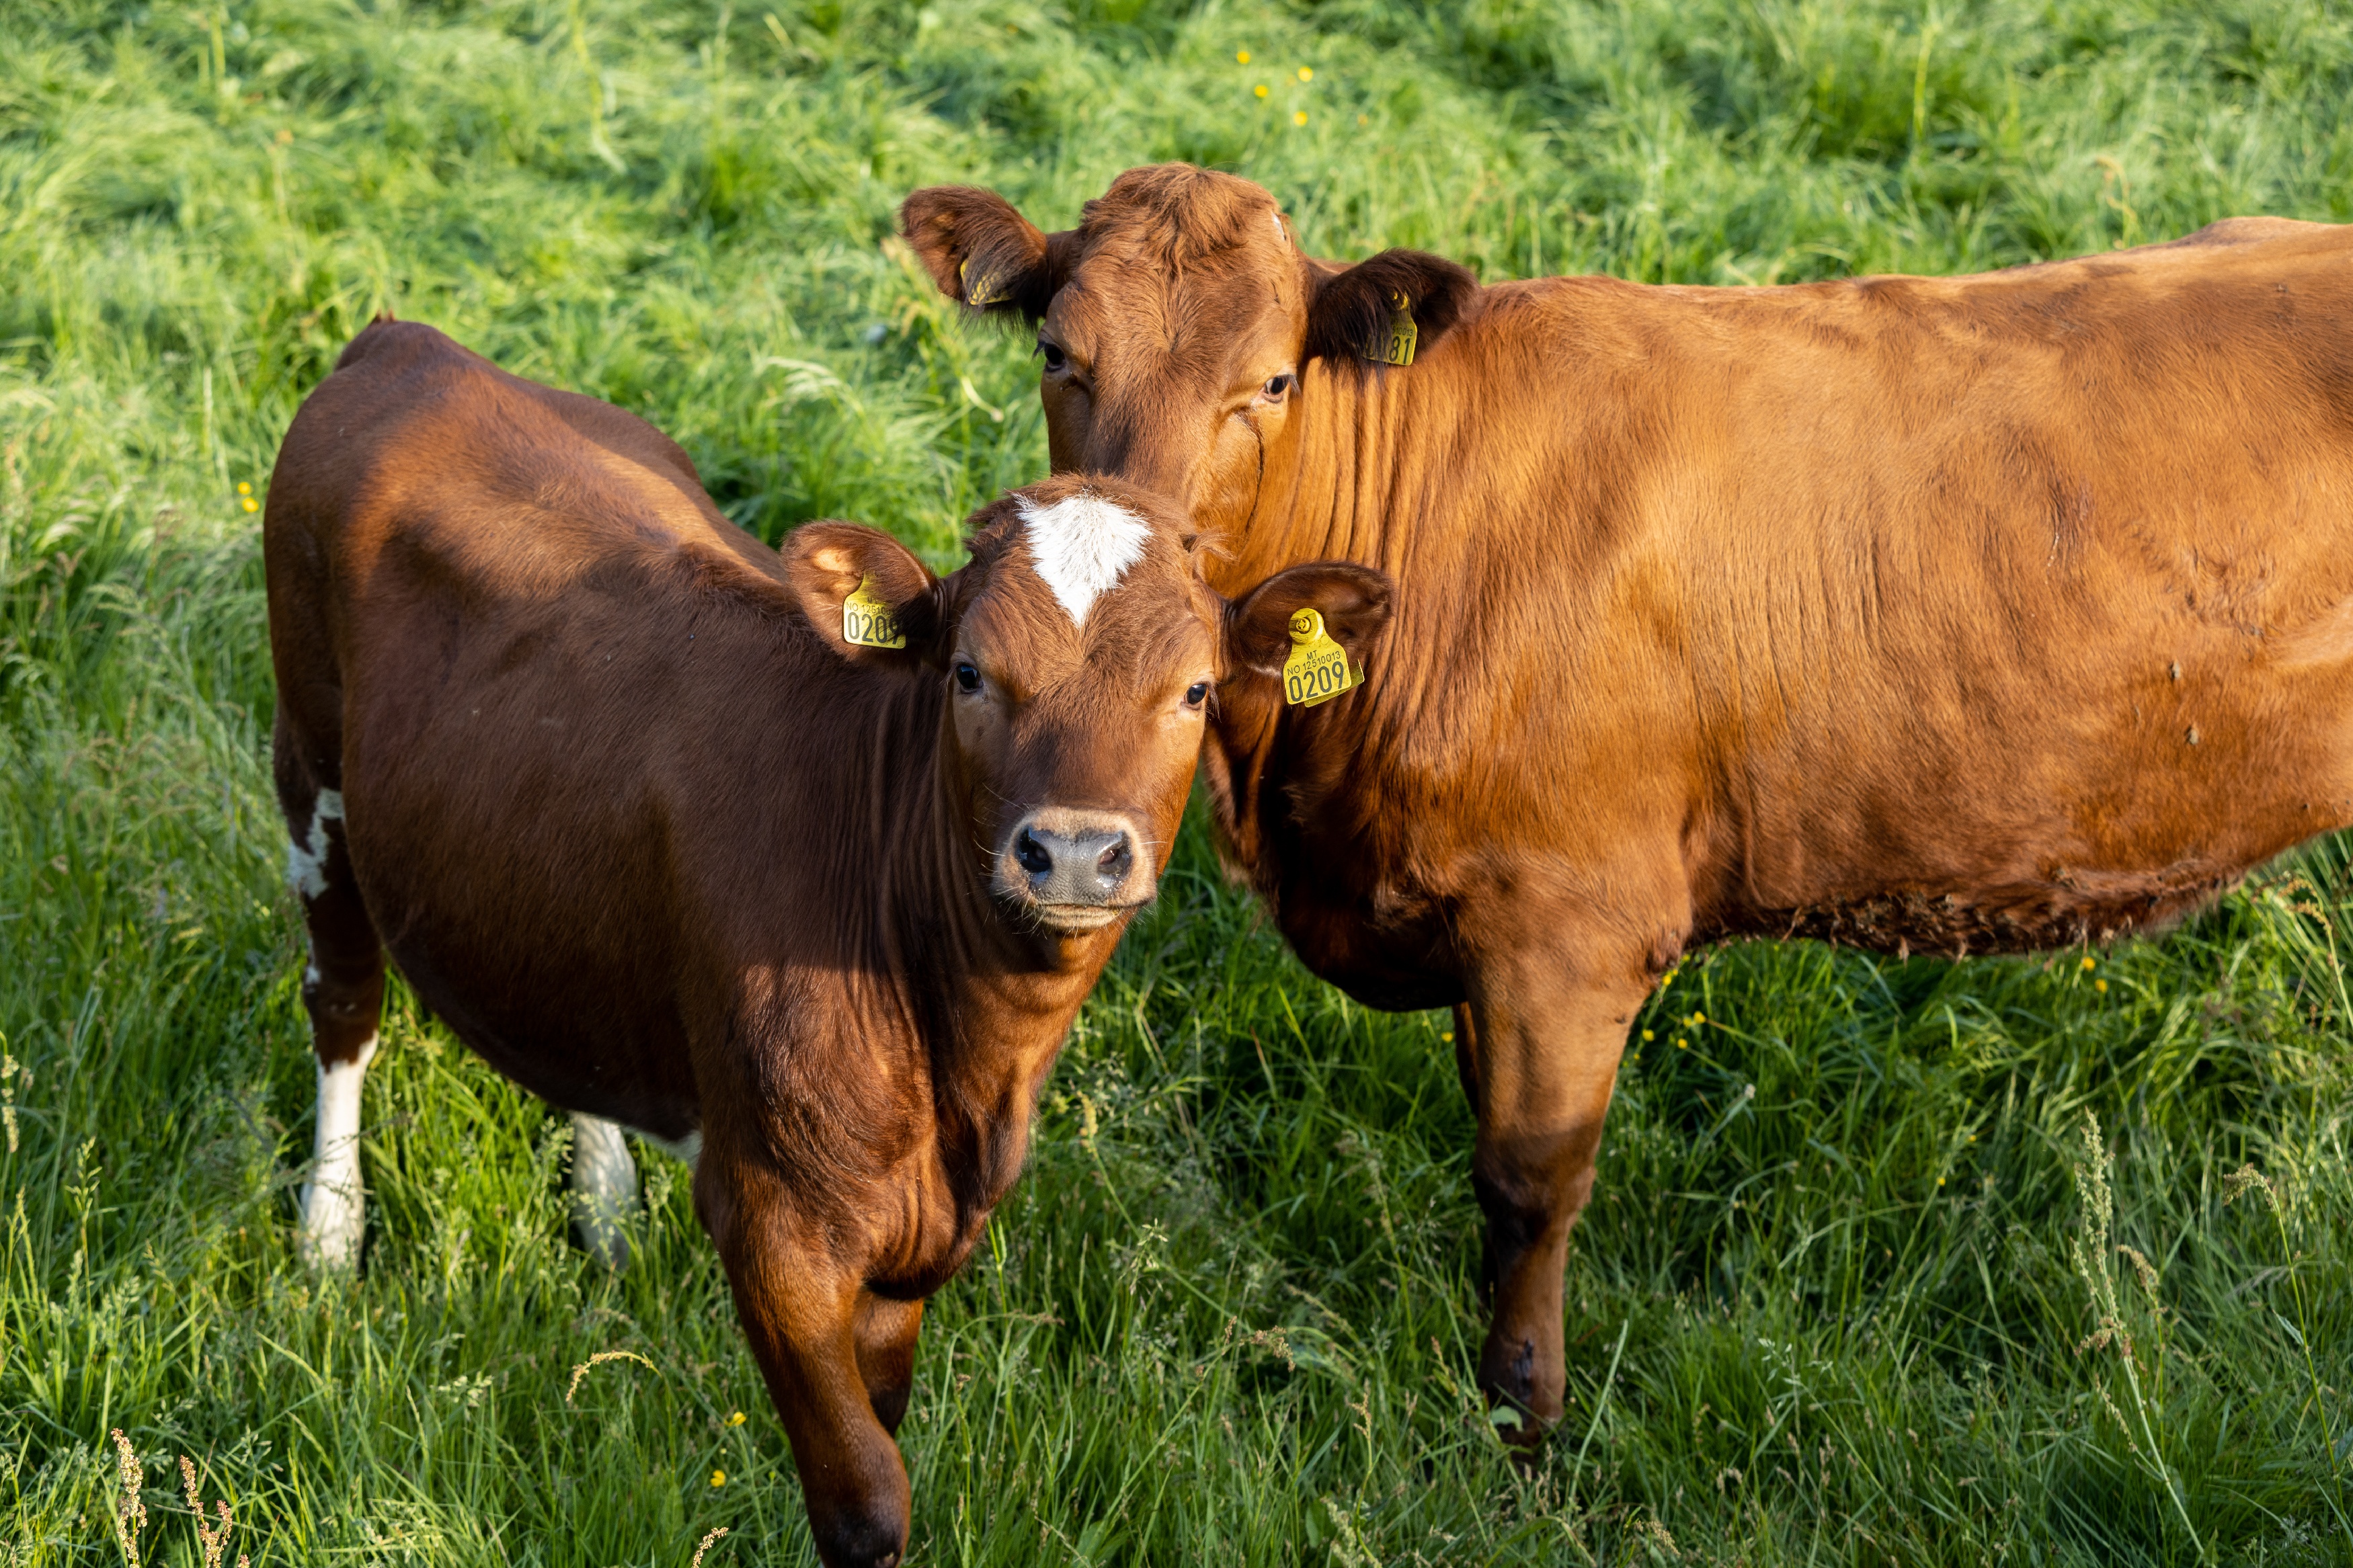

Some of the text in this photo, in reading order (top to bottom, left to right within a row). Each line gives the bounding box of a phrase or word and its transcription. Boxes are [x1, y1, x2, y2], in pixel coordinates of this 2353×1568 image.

[846, 602, 891, 616] NO 125100
[848, 612, 898, 645] 0209
[1287, 651, 1341, 676] NO 12510013
[1306, 650, 1317, 660] MT
[1289, 661, 1344, 702] 0209
